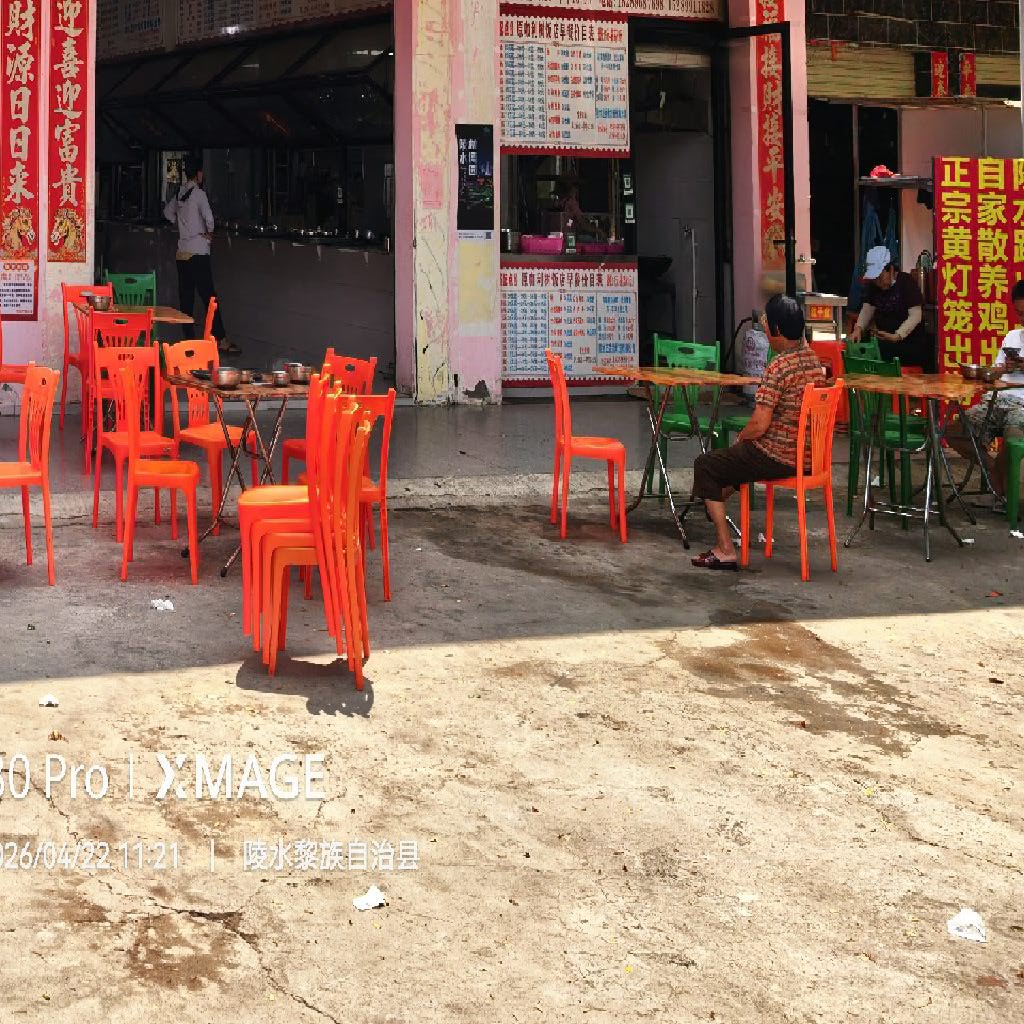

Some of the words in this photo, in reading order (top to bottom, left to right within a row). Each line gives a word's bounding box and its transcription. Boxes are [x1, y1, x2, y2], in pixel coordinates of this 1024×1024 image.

[940, 156, 975, 405] 正宗黄灯笼出
